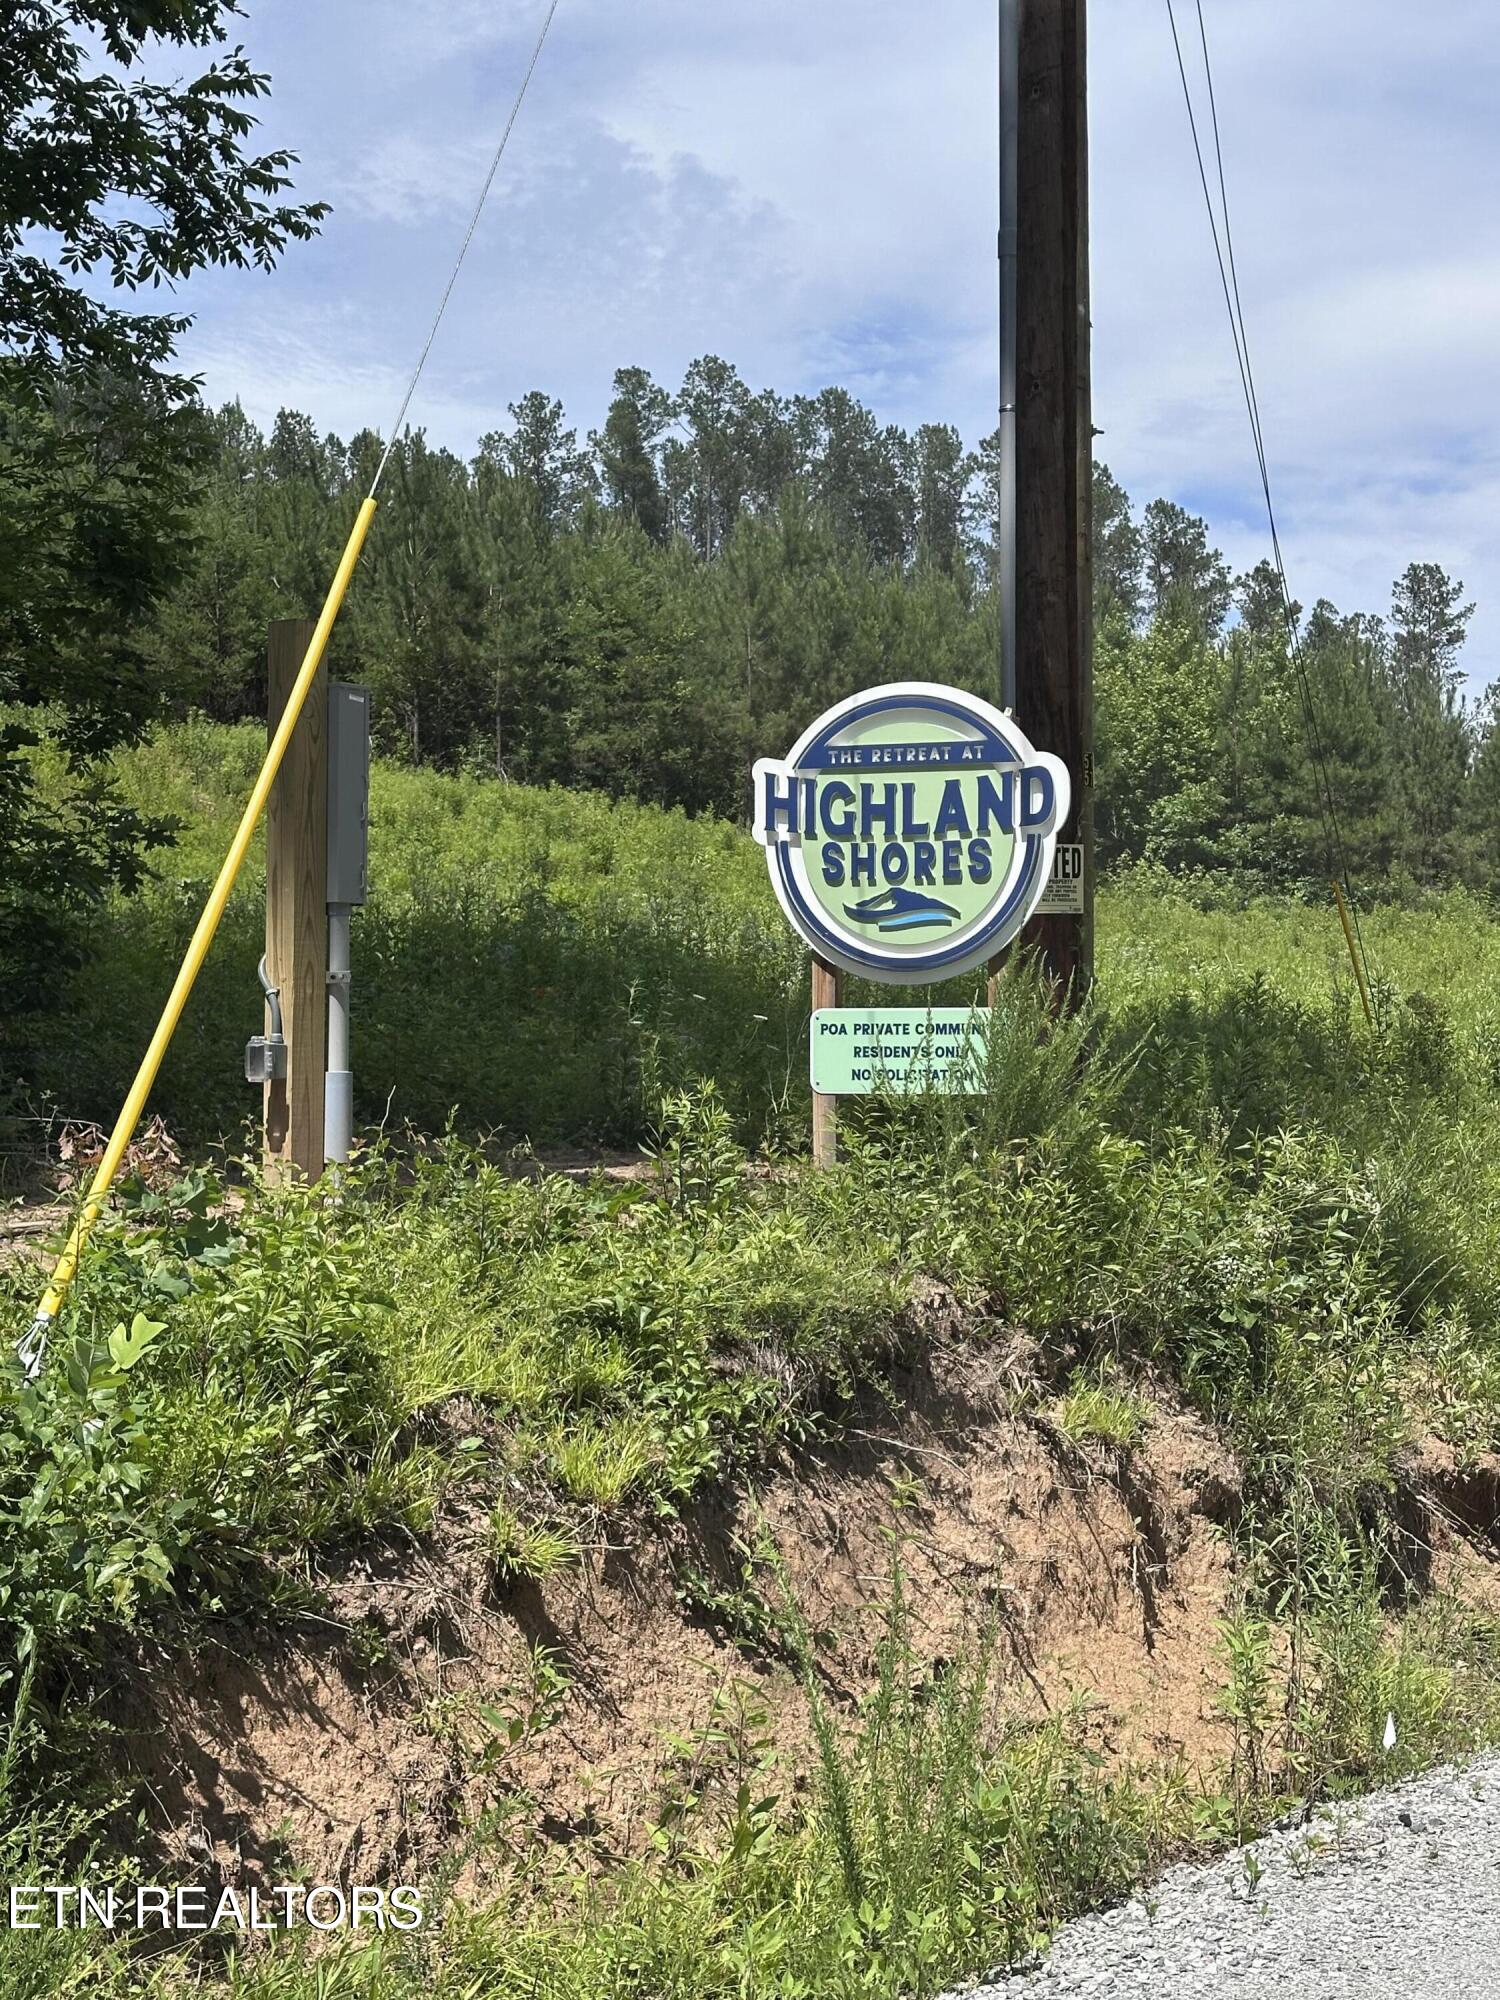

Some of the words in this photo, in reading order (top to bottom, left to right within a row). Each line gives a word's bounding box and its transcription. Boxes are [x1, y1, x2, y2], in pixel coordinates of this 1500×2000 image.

[828, 750, 863, 765] THE
[871, 746, 951, 763] RETREAT
[962, 745, 985, 760] AT
[764, 765, 1057, 841] HIGHLAND
[821, 838, 993, 886] SHORES
[1054, 847, 1082, 879] TED
[820, 1023, 848, 1036] POA
[853, 1023, 911, 1036] PRIVATE
[915, 1023, 982, 1036] COMMUN
[853, 1046, 931, 1058] RESIDENTS
[935, 1046, 962, 1058] ONL
[851, 1069, 872, 1081] NO
[876, 1069, 974, 1081] SOLICITATON
